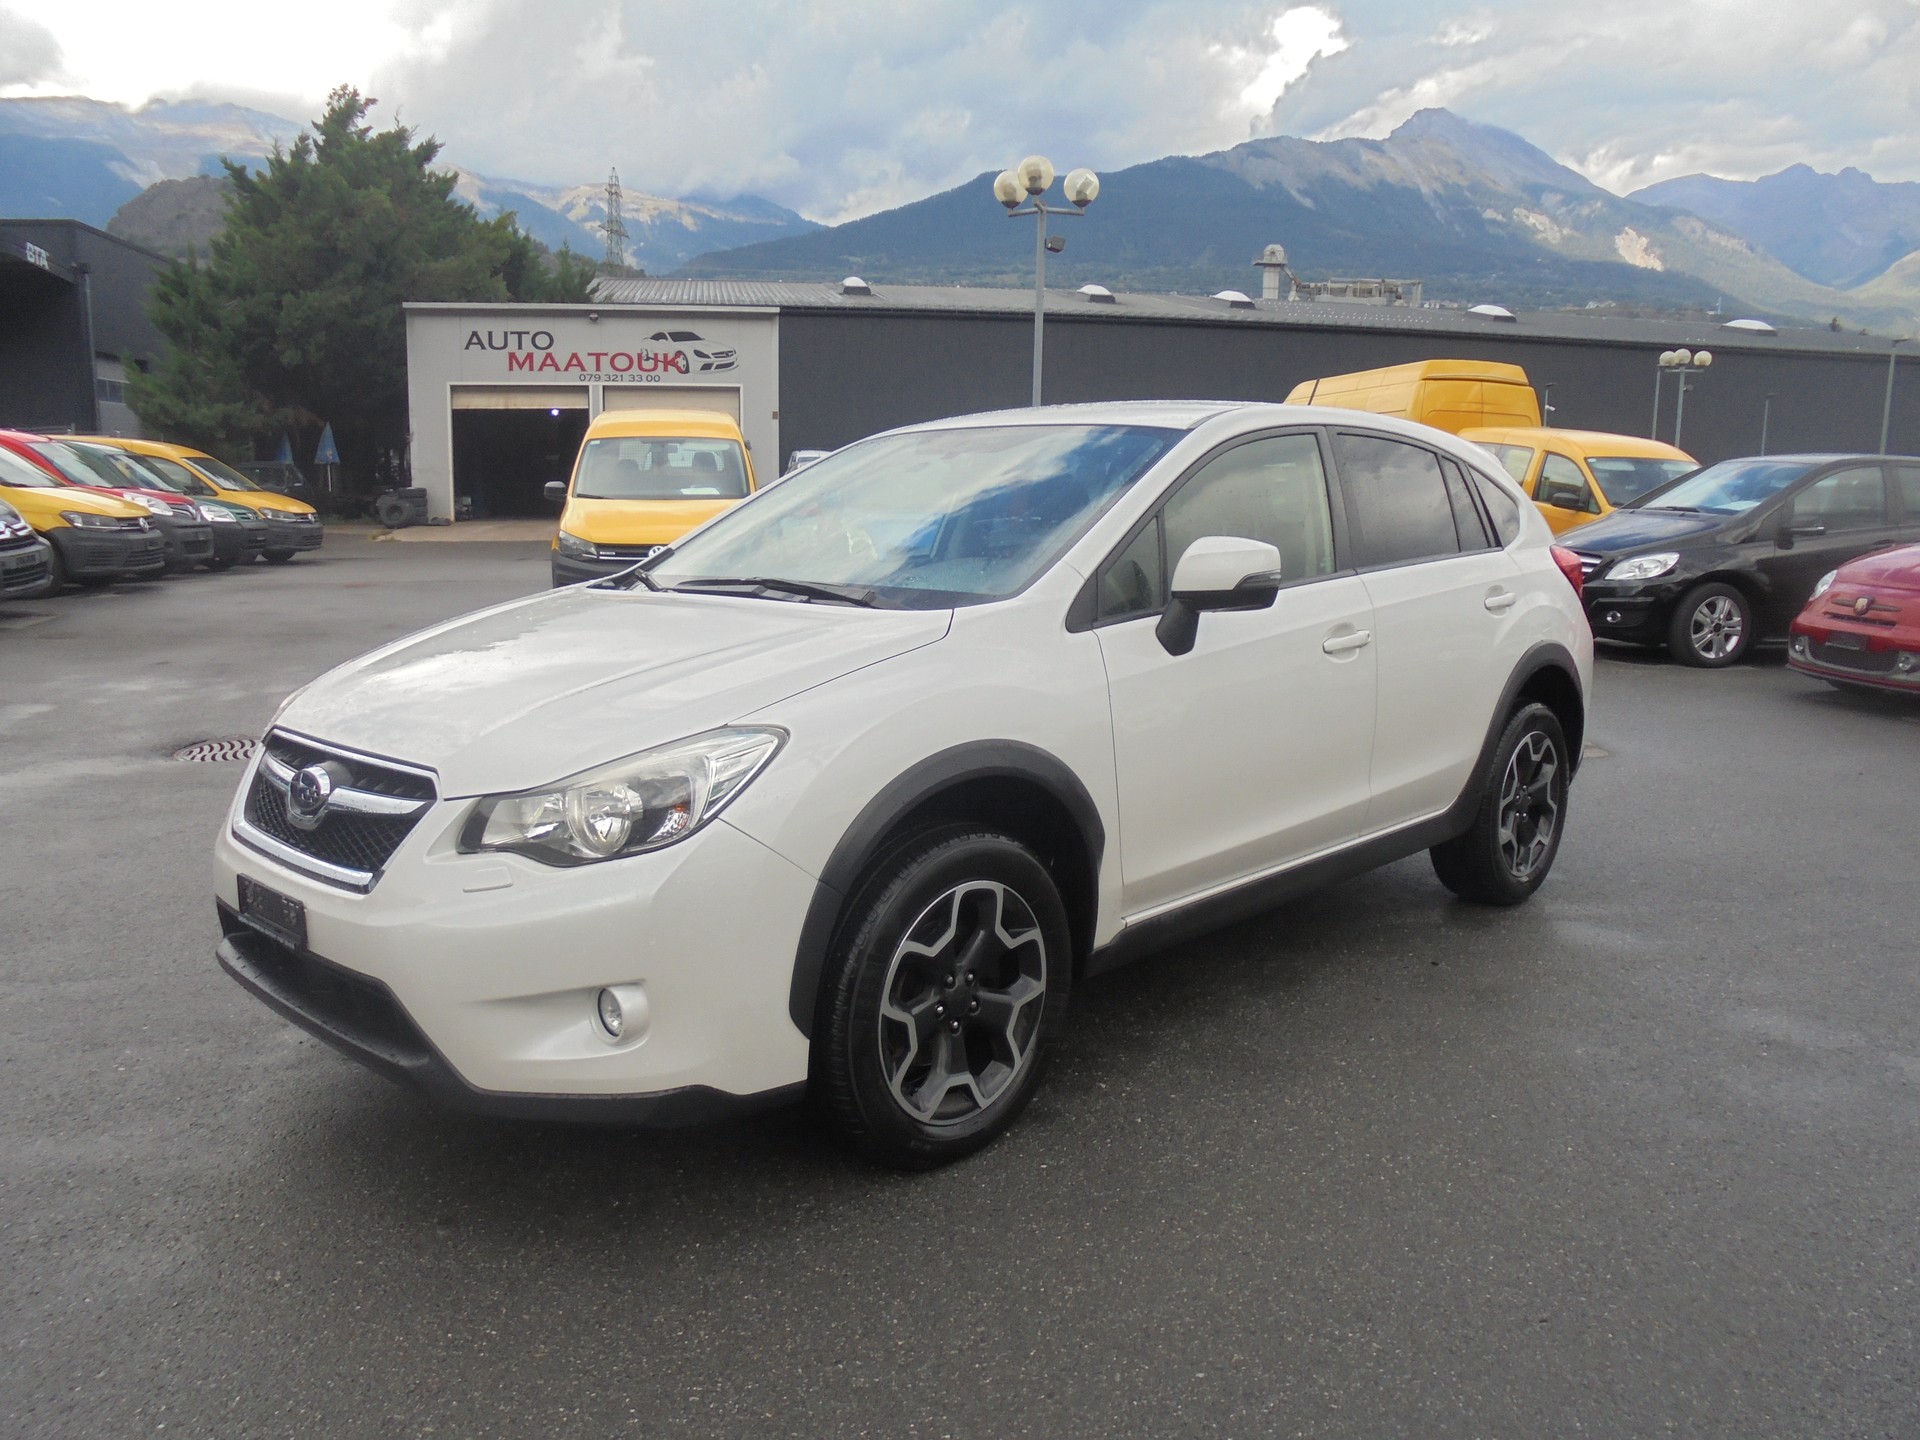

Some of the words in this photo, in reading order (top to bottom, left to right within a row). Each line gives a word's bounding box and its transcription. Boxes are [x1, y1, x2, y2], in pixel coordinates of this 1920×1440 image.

[464, 330, 555, 351] AUTO
[508, 351, 683, 373] MAATOUK
[578, 373, 602, 382] 079
[603, 374, 624, 383] 321
[628, 374, 643, 383] 33
[645, 374, 661, 383] 00
